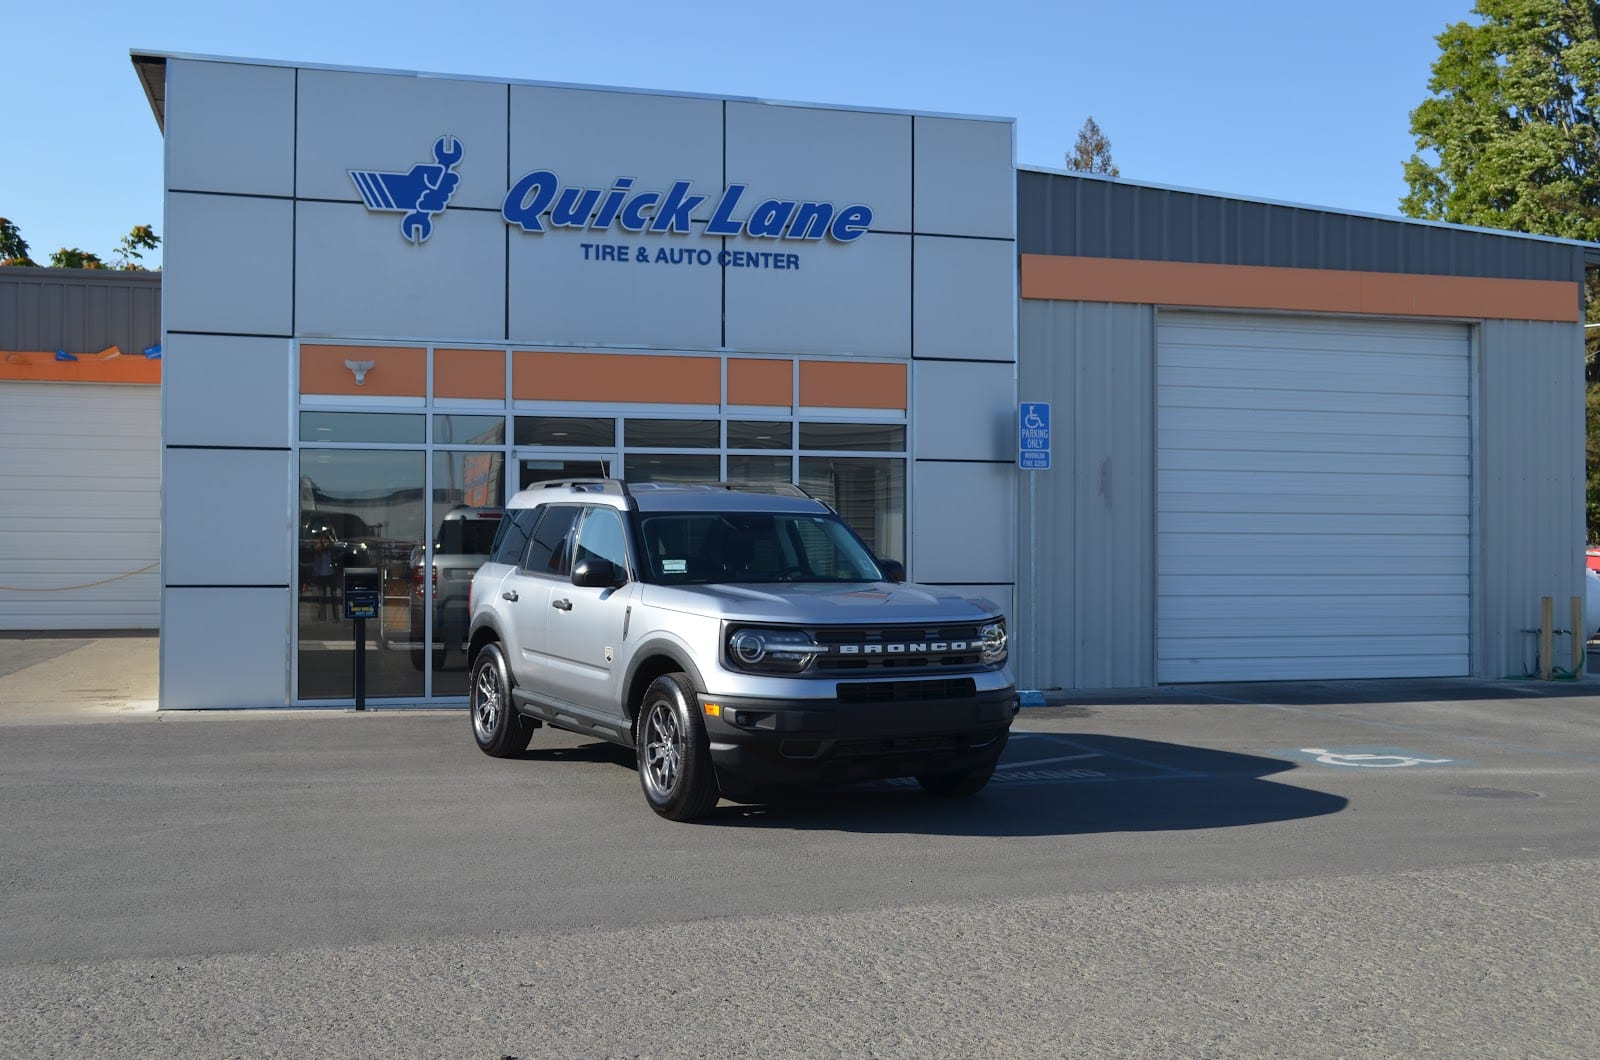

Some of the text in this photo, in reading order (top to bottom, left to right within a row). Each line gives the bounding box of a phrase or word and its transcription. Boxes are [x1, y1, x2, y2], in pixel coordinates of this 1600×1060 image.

[501, 169, 874, 243] Quick Lane
[580, 243, 800, 270] TIRE & AUTO CENTER
[1022, 428, 1048, 440] PARKING
[1027, 438, 1043, 448] ONLY
[839, 641, 967, 654] BRONCO
